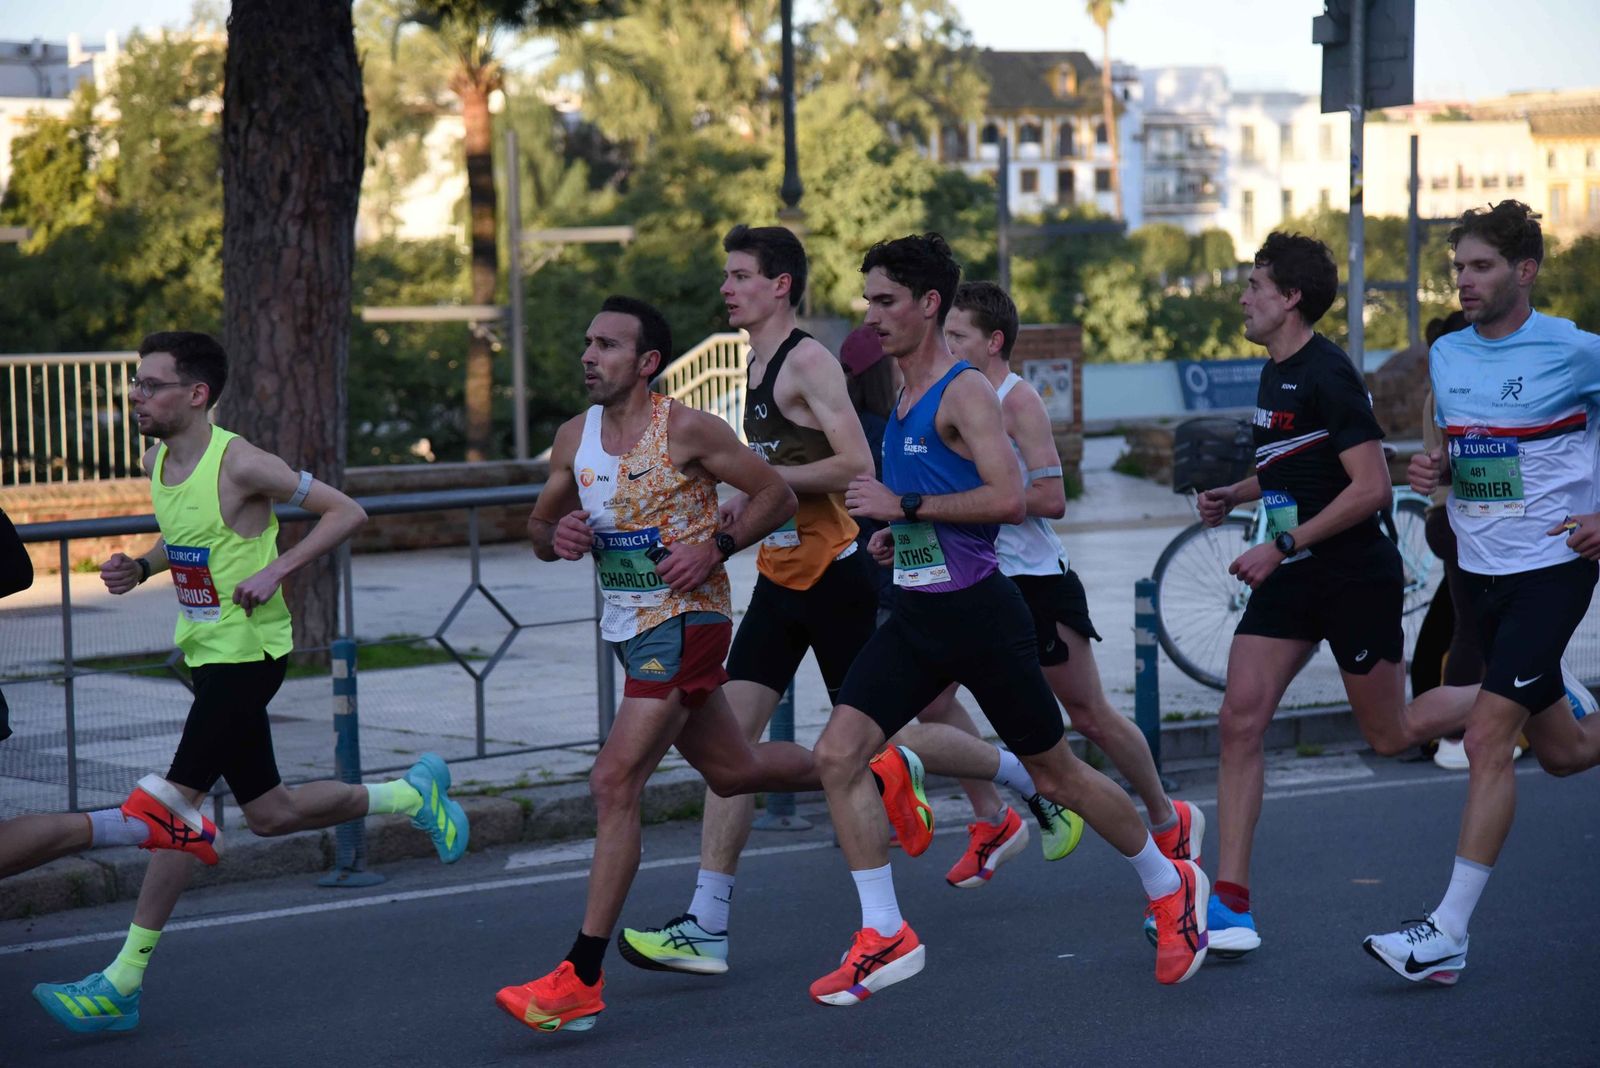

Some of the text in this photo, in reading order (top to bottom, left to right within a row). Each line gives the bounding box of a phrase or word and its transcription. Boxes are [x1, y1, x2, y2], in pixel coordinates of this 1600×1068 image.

[1464, 442, 1507, 455] ZURICH
[596, 474, 610, 482] NN
[1470, 467, 1487, 478] 481
[1459, 481, 1513, 498] TERRIER
[607, 534, 650, 547] ZURICH
[169, 549, 201, 563] ZURICH
